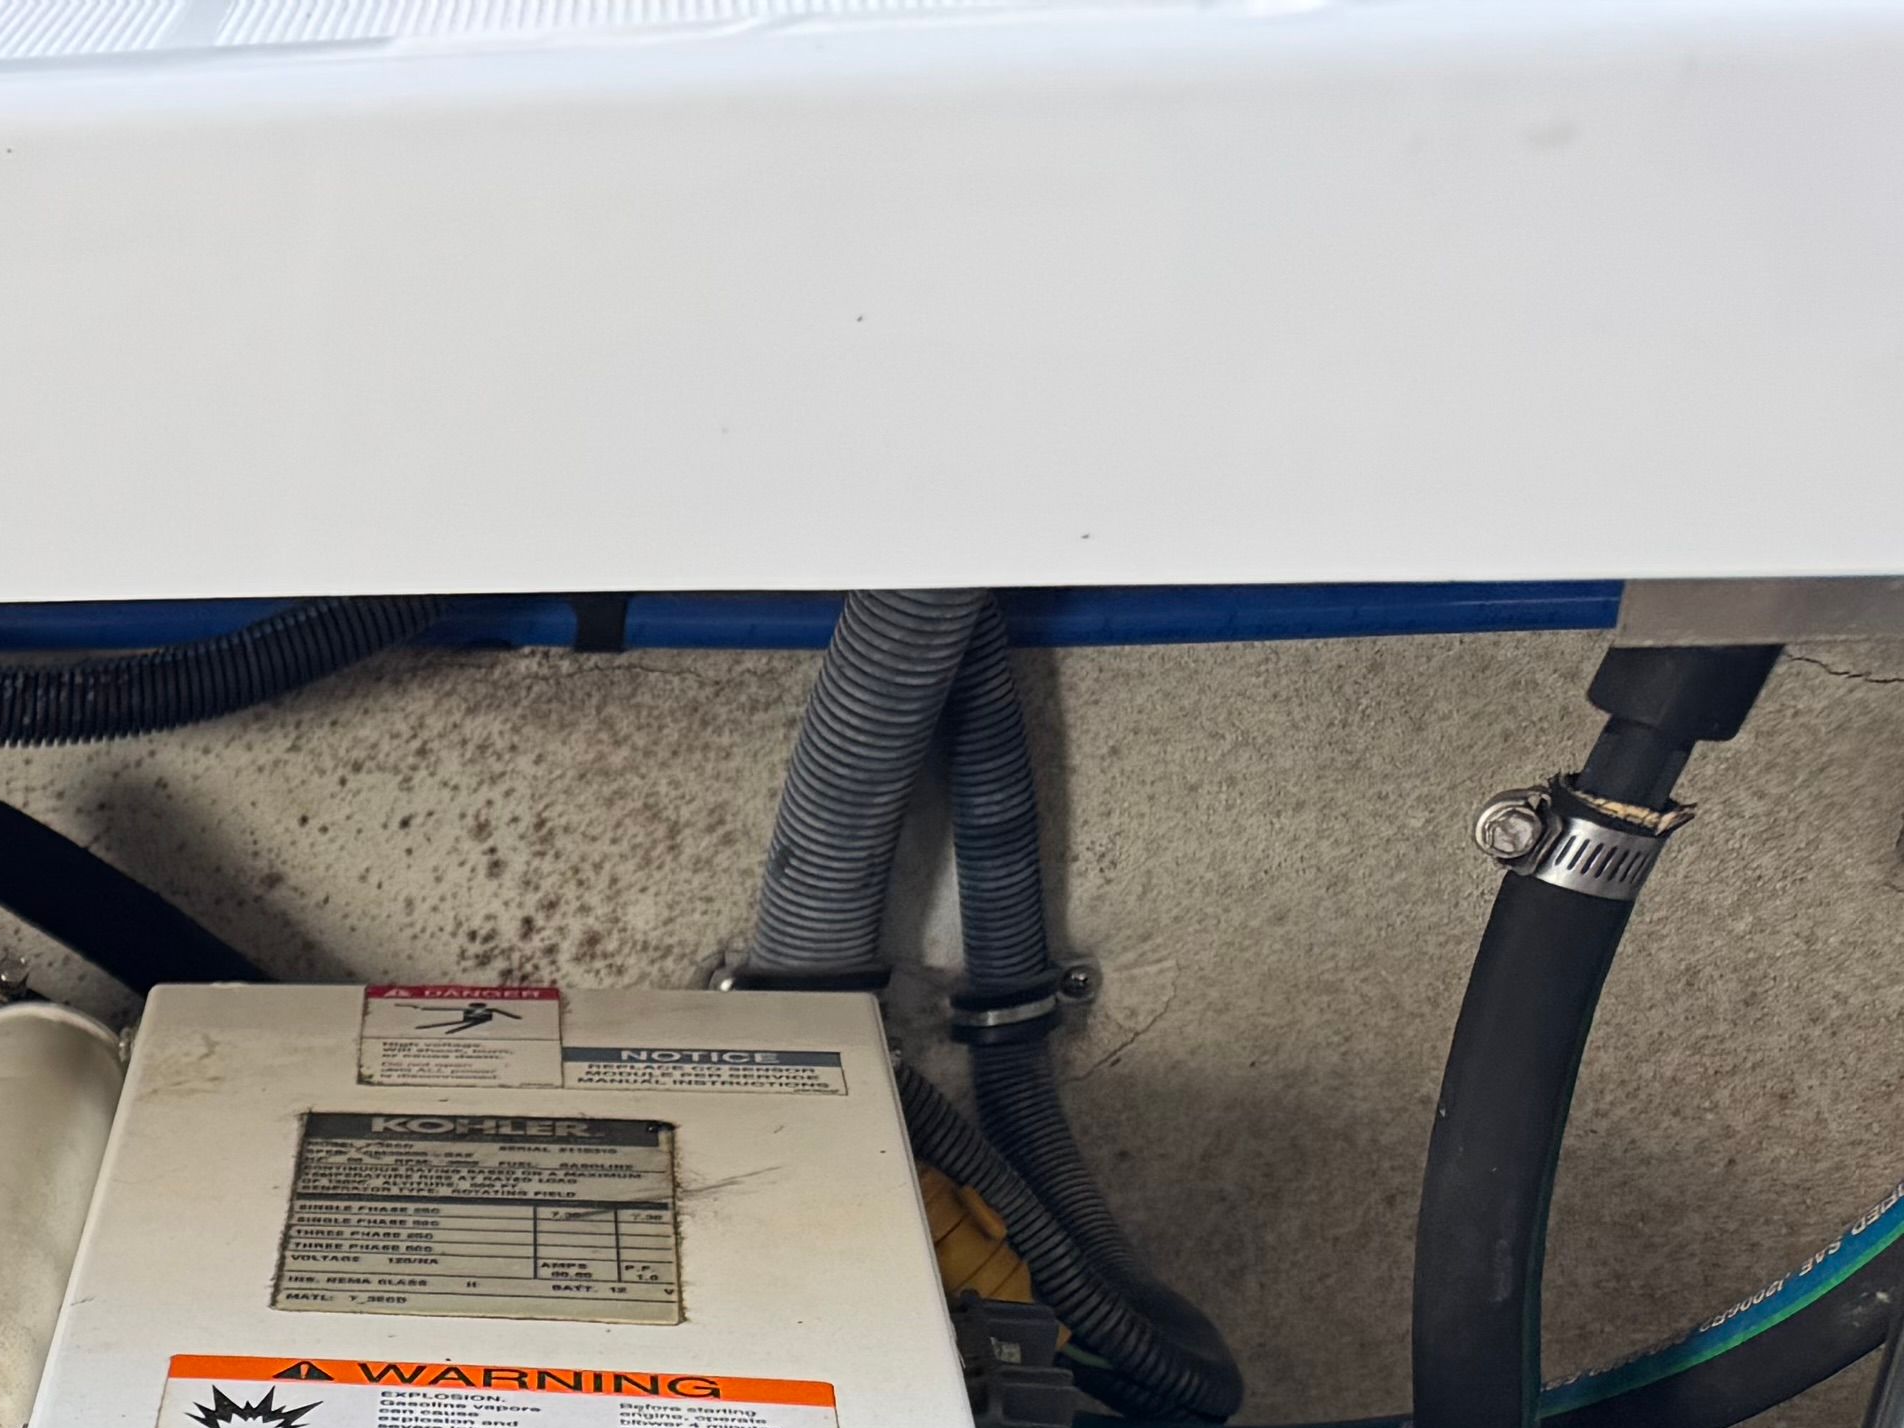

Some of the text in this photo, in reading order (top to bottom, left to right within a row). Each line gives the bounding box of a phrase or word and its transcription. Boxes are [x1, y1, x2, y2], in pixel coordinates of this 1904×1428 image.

[425, 988, 540, 998] DANGER
[621, 1050, 780, 1064] NOTICE
[588, 1064, 815, 1074] REPLACE SENSOR
[585, 1070, 674, 1079] MODULE
[725, 1073, 820, 1081] SERVICE
[577, 1078, 830, 1089] MANUAL INSTRUCTIONS
[371, 1118, 591, 1137] KOHLER
[358, 1363, 721, 1398] WARNING
[380, 1391, 505, 1403] EXPLOSION.
[377, 1414, 489, 1426] explosion
